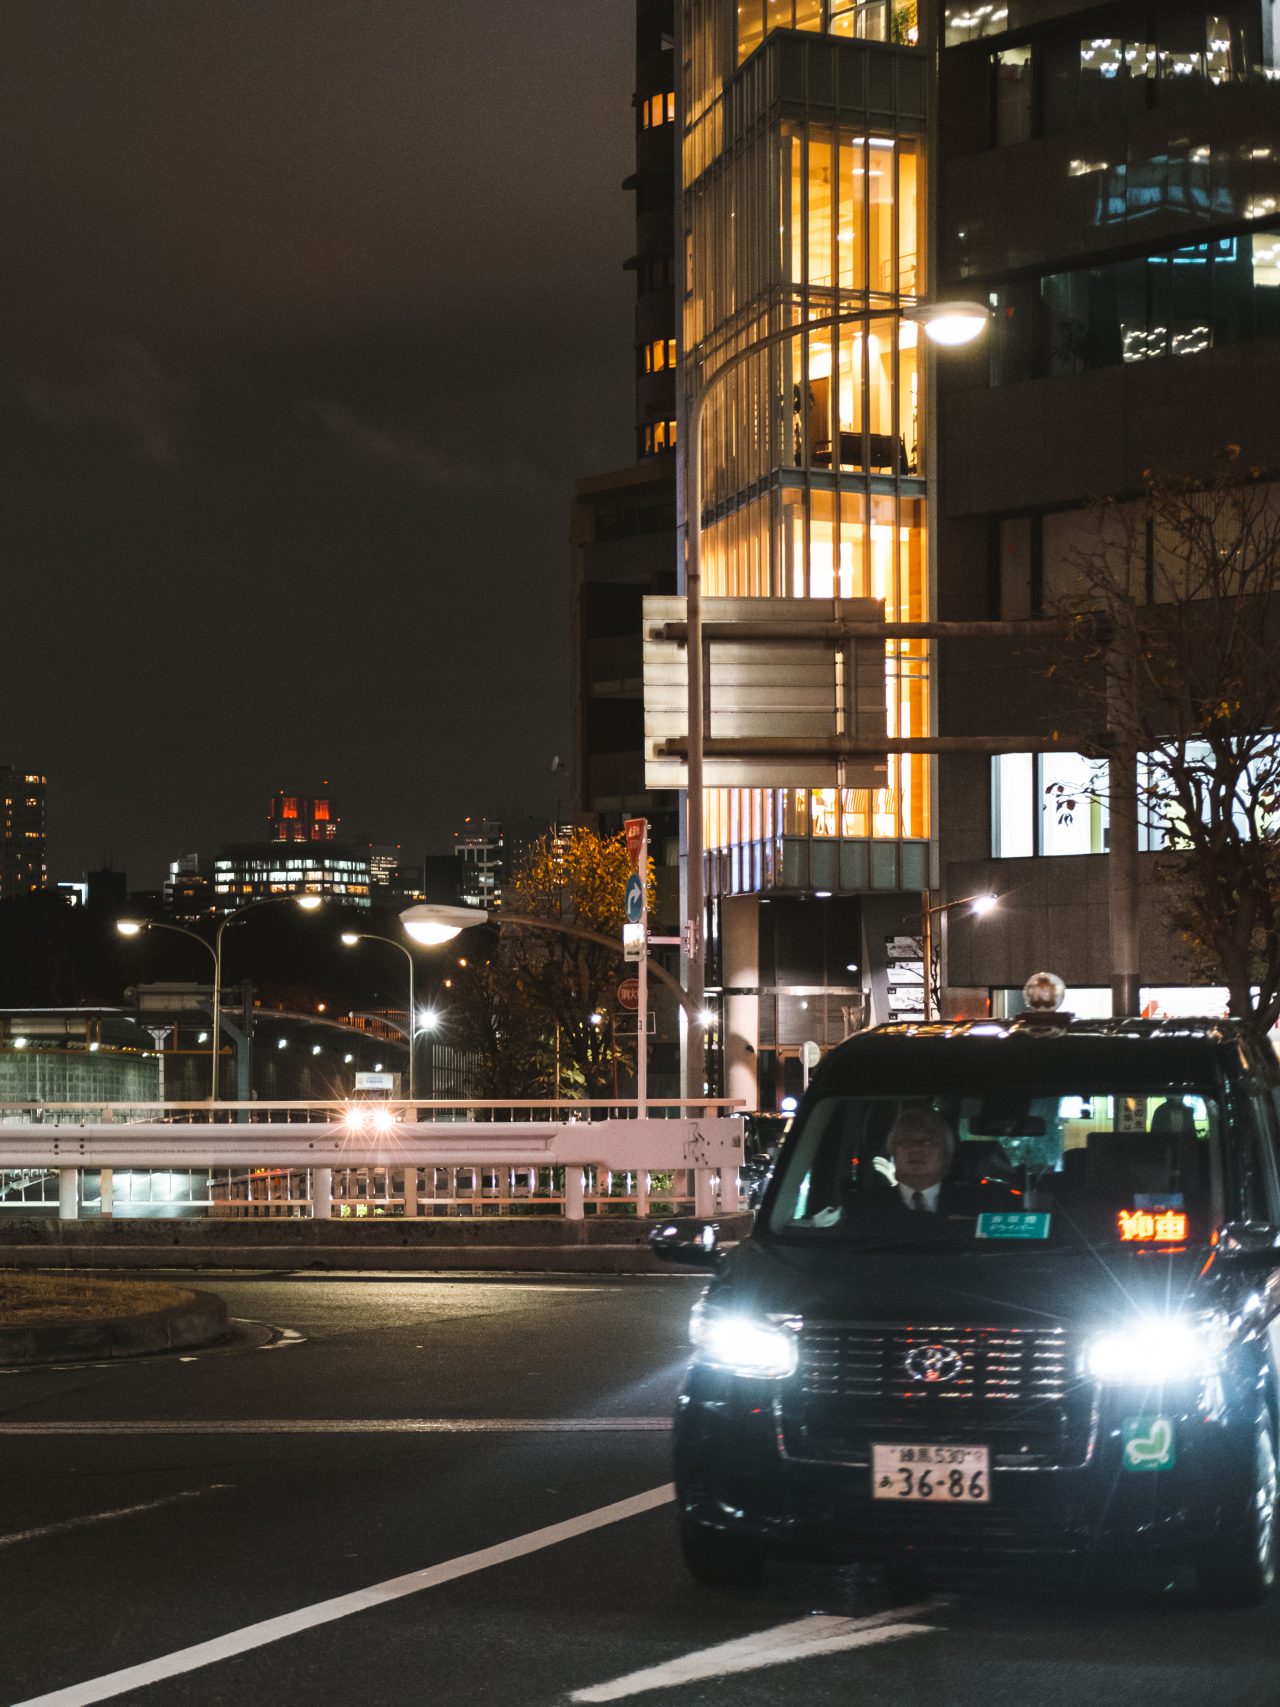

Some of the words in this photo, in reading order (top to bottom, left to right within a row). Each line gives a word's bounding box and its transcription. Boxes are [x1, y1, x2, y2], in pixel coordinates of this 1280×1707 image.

[621, 987, 639, 1000] 消火
[1119, 1210, 1186, 1241] 迎車
[934, 1447, 965, 1464] 530
[898, 1467, 984, 1498] 36-86
